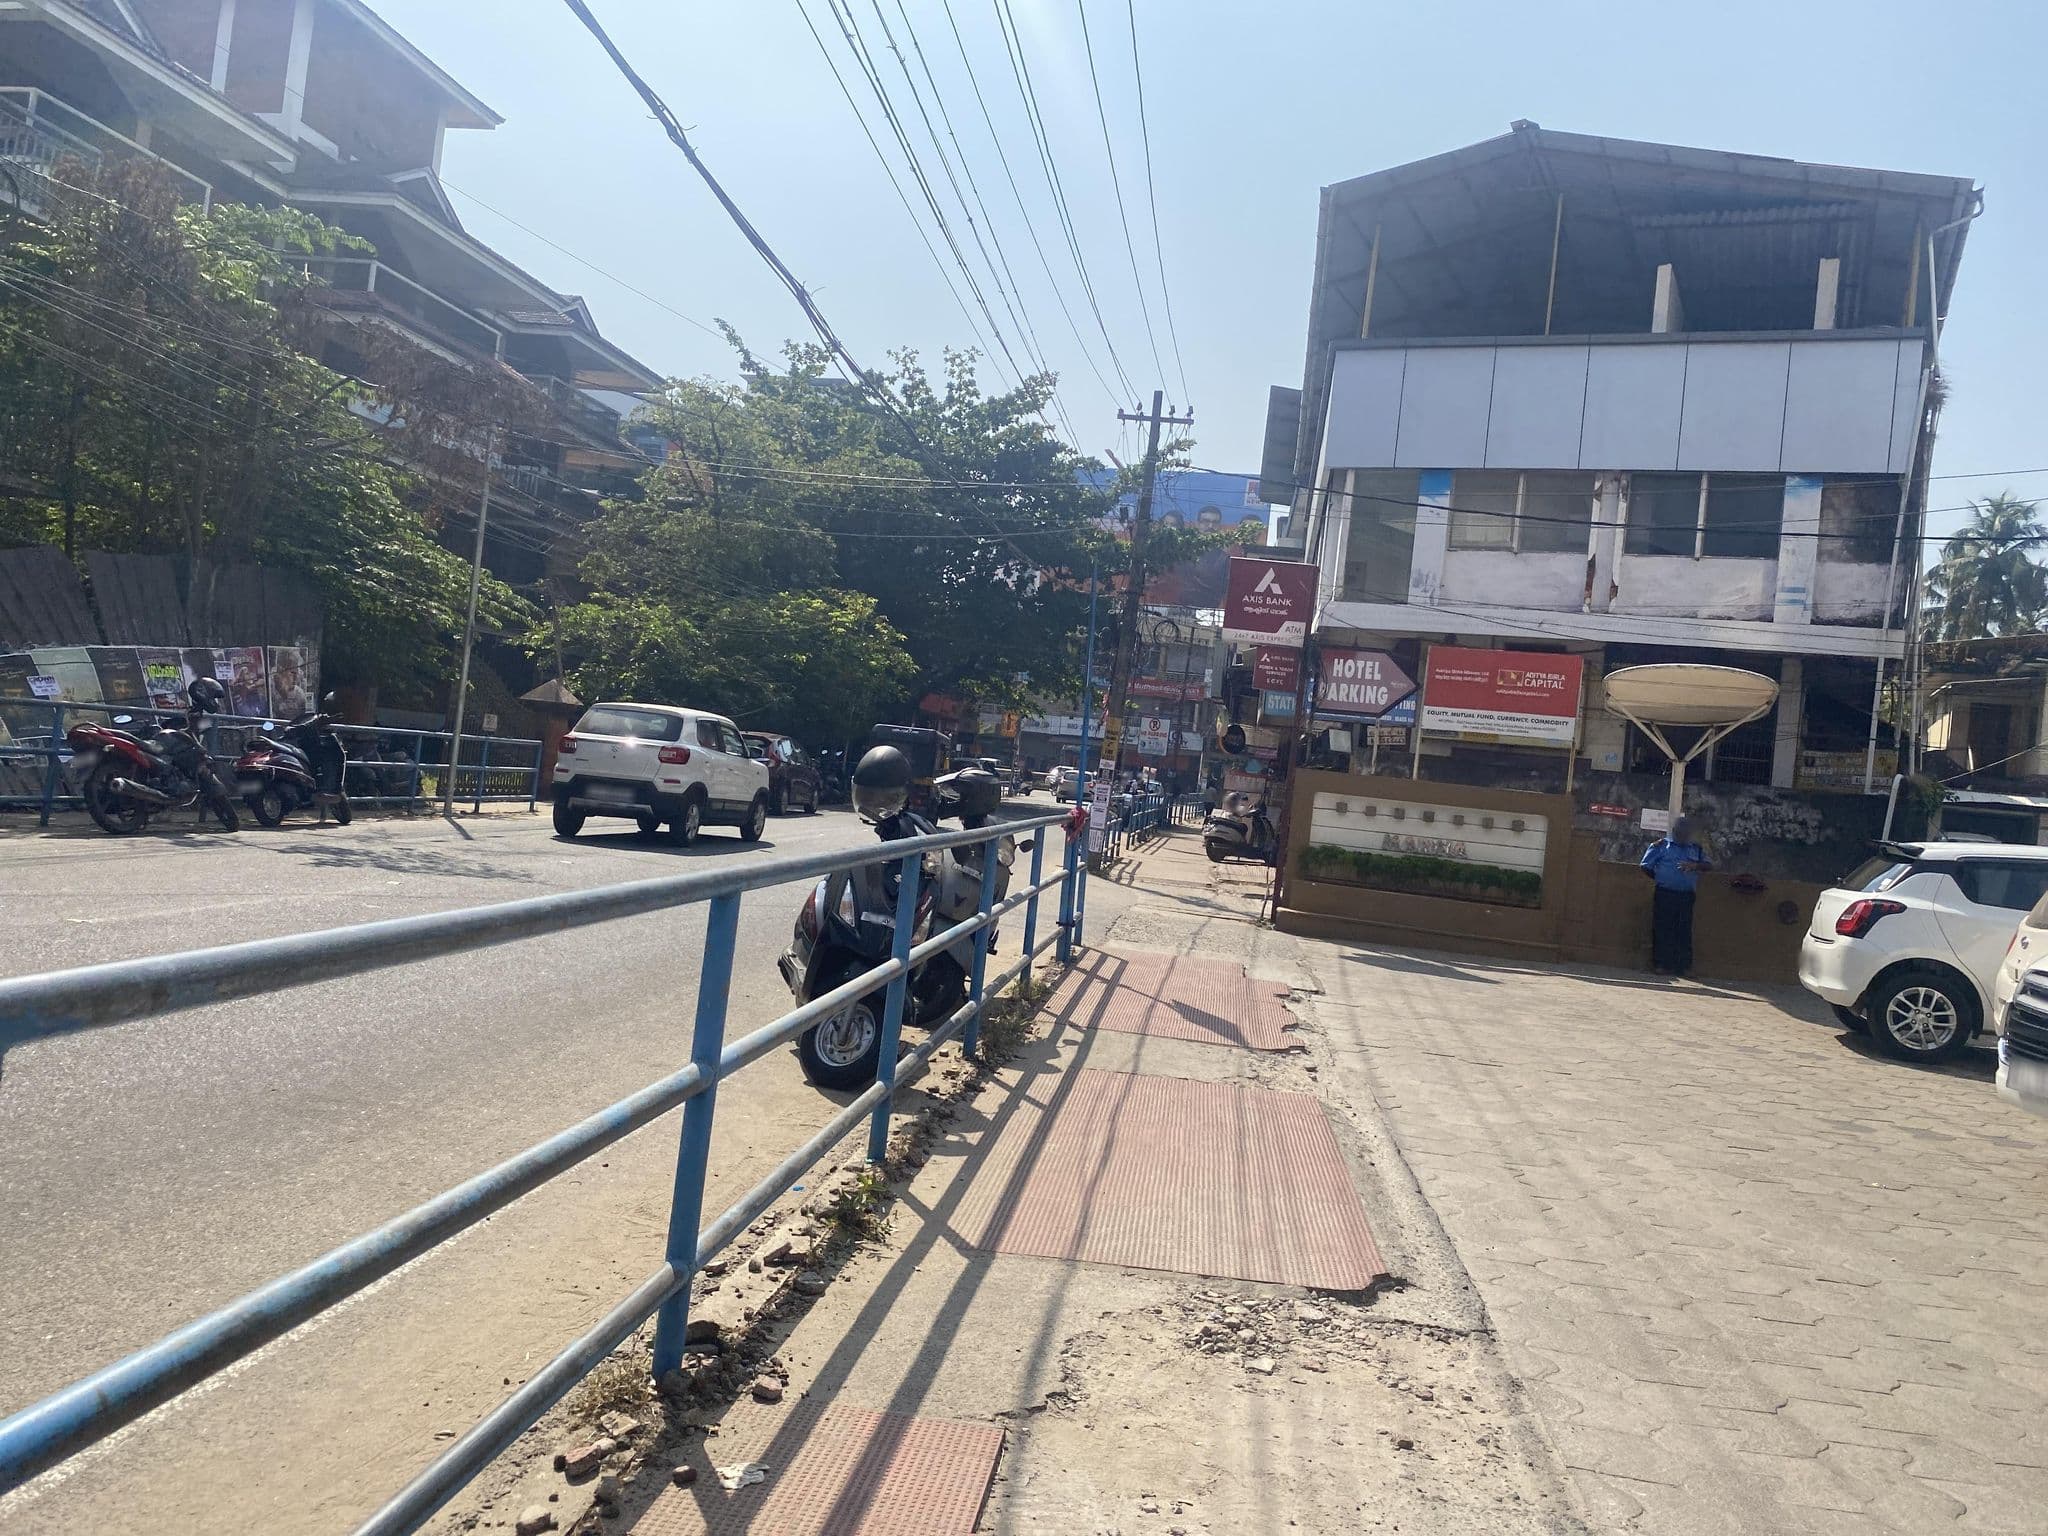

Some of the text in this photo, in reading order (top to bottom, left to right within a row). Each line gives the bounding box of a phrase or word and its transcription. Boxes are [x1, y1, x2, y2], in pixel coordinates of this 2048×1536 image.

[1242, 595, 1292, 606] AXIS BANK
[1285, 625, 1302, 635] ATM
[1333, 658, 1381, 680] HOTEL
[1525, 671, 1566, 681] ADITYA BIRLA
[1524, 678, 1565, 690] CAPITAL
[1427, 709, 1449, 717] EQUITY,
[1477, 713, 1495, 721] FUND,
[1497, 715, 1529, 724] CURRENCY,
[1530, 718, 1569, 727] COMMODITY
